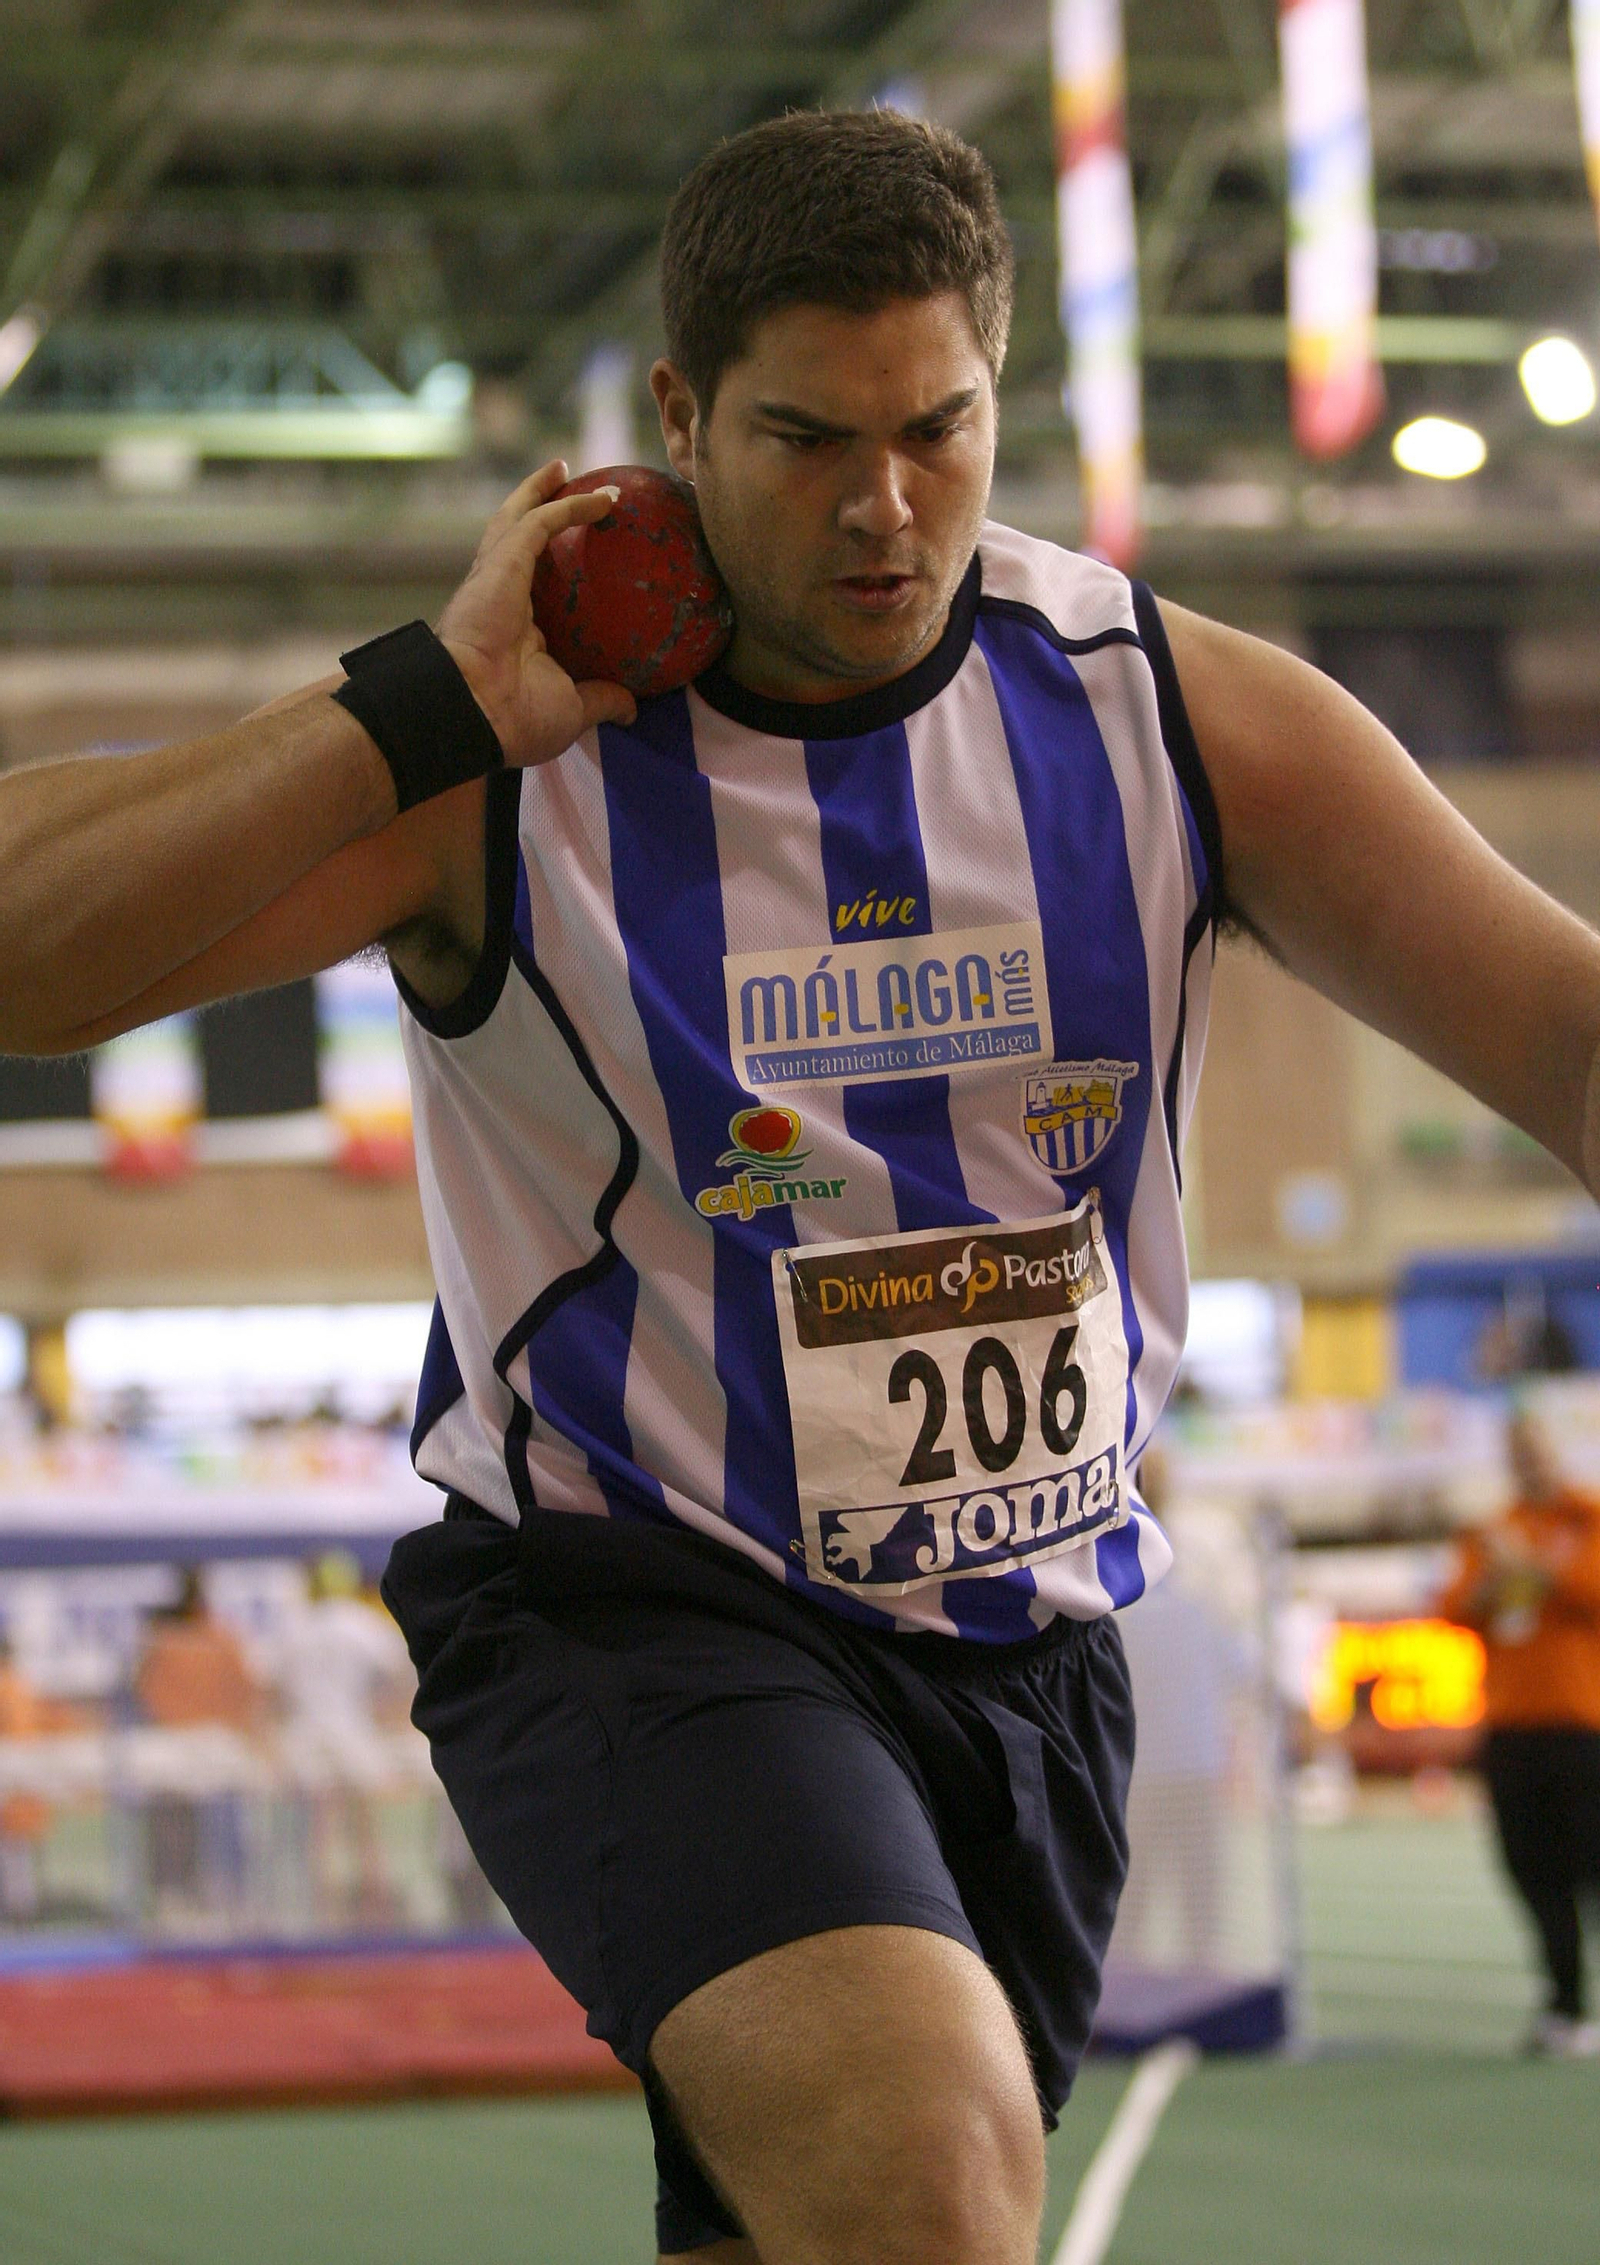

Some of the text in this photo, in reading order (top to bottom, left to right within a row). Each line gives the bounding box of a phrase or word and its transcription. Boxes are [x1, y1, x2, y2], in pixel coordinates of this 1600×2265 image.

[752, 1031, 1034, 1085] Ayuntamiento de Málaga
[699, 1176, 846, 1219] cajamar
[819, 1270, 933, 1316] Divina
[888, 1325, 1088, 1487] 206
